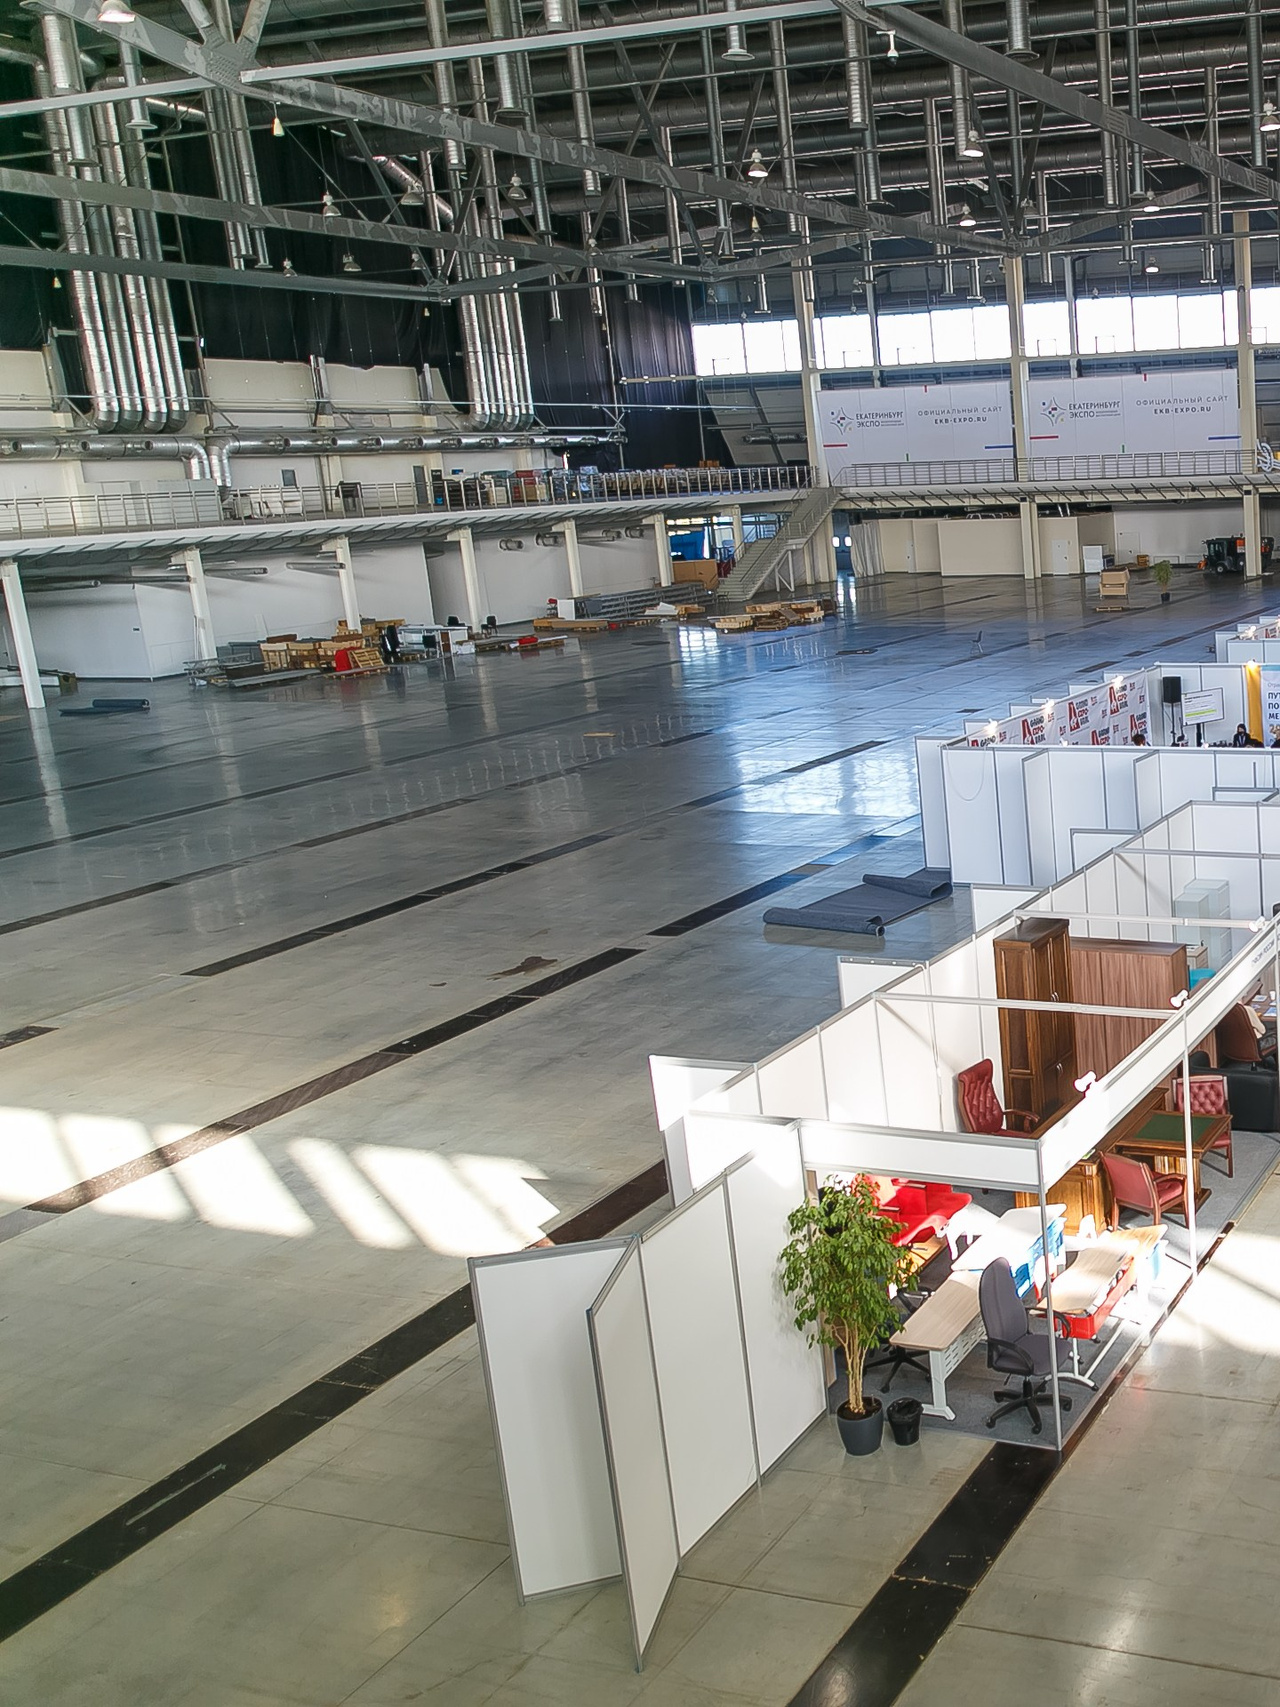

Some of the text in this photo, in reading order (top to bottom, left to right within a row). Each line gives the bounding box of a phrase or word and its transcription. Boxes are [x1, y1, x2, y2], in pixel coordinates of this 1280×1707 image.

[1136, 395, 1228, 406] ОФИЦИАЛЬНЫЙ САЙТ
[1069, 401, 1120, 410] ЕКАТЕРИНБУРГ
[917, 407, 979, 416] ОФИЦИАЛЬНЫЙ
[1069, 411, 1095, 419] ЭКСПО
[1154, 406, 1211, 415] EKB-EXPO.RU
[855, 411, 903, 420] ЕКАТЕРИНБУРГ
[856, 420, 881, 428] ЭКСПО
[934, 416, 988, 425] EKB-EXPO.RU
